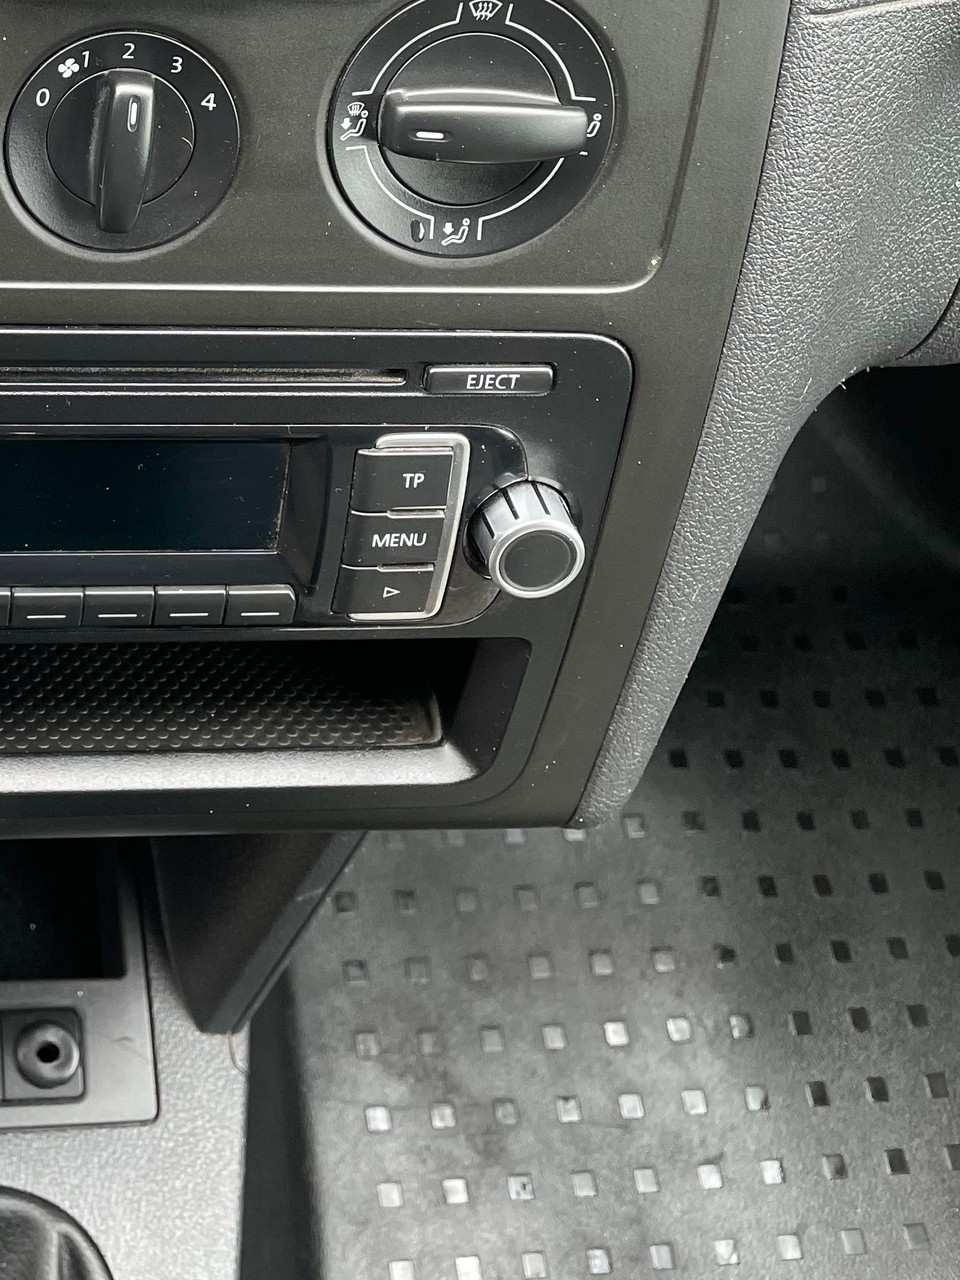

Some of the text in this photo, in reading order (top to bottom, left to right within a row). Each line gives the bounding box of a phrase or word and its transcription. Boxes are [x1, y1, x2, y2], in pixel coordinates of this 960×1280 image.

[81, 50, 91, 68] 1
[121, 43, 136, 60] 2
[170, 56, 184, 74] 3
[35, 87, 50, 108] 0
[200, 92, 217, 111] 4
[465, 374, 521, 390] EJECT
[402, 472, 426, 490] TP
[371, 532, 428, 548] MENU
